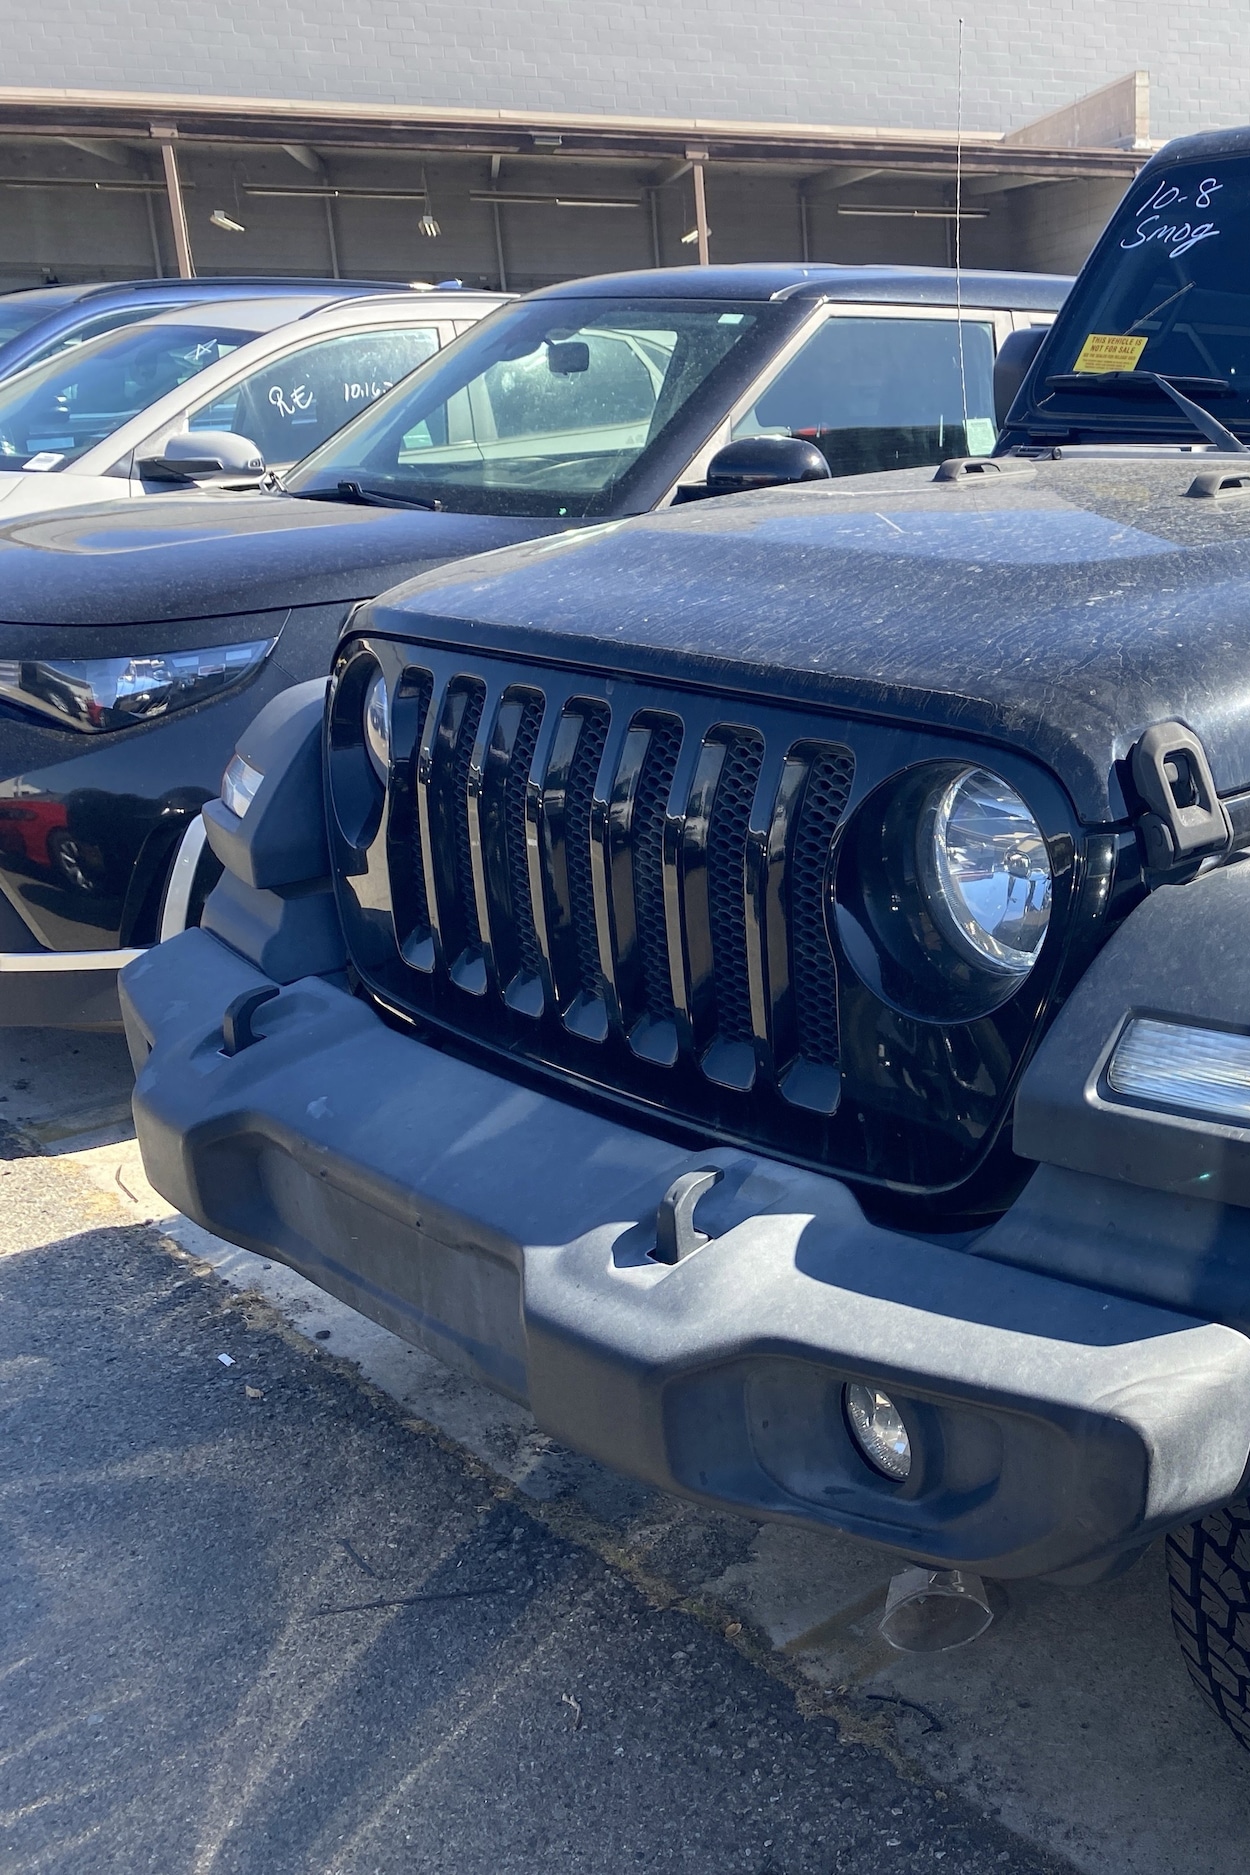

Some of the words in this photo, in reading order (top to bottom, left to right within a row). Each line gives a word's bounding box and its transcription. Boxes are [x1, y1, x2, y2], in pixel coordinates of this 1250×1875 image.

[1092, 336, 1107, 344] THIS
[1107, 337, 1134, 346] VEHICLE
[1135, 338, 1143, 346] IS
[1104, 345, 1117, 353] FOR
[1118, 346, 1136, 354] SALE
